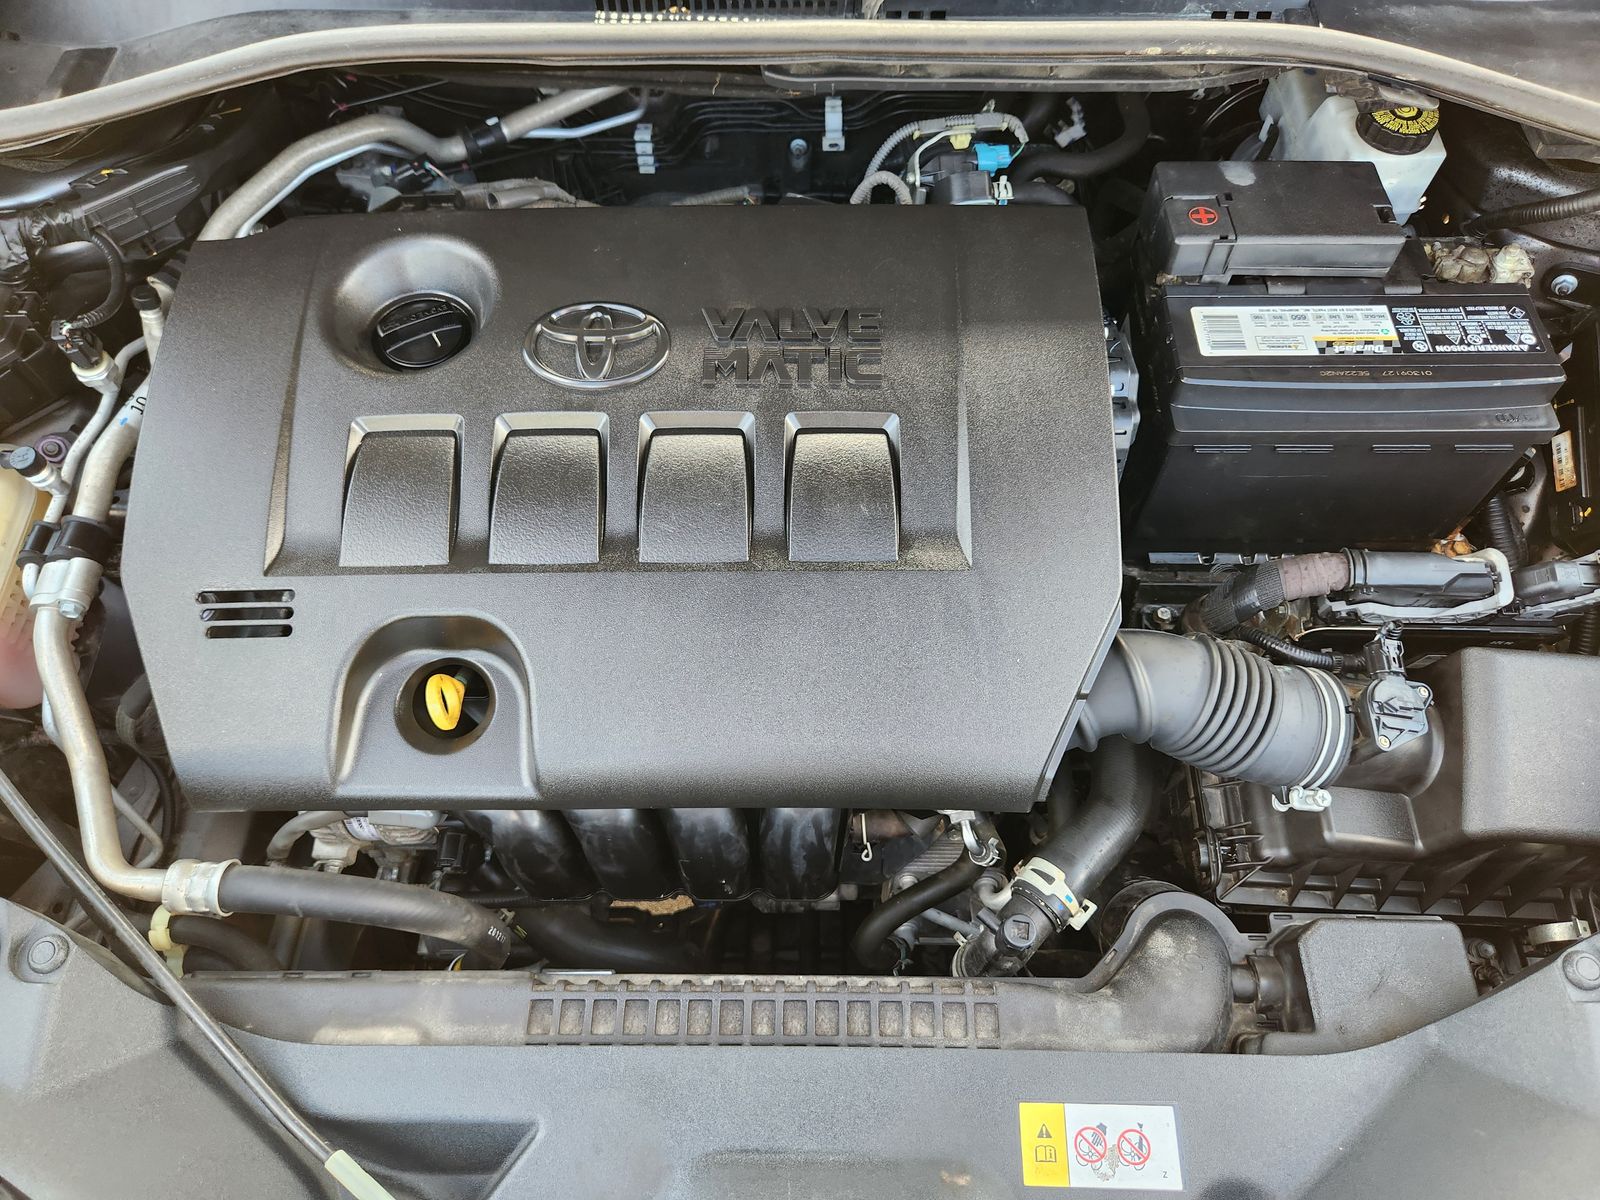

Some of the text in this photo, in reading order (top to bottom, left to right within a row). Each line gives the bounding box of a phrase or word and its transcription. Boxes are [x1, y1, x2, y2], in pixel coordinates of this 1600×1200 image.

[701, 307, 882, 343] VALVE
[701, 346, 883, 387] MATIC
[1333, 344, 1387, 353] Duralast
